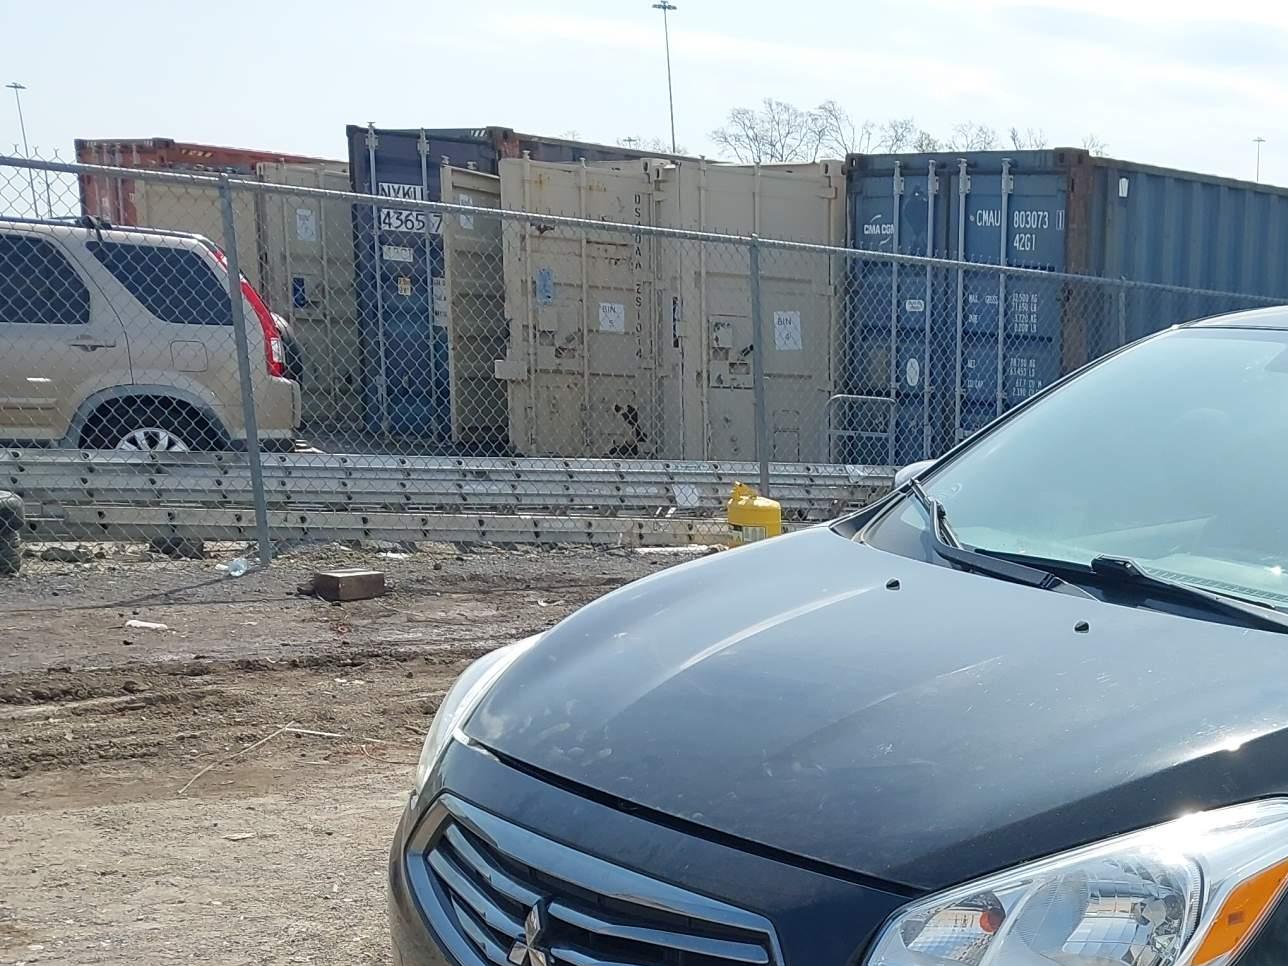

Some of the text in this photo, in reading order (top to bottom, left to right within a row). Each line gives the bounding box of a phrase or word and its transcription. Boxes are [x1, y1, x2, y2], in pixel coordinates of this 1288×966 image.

[976, 209, 1001, 227] CMAU
[1013, 211, 1049, 229] 803073
[864, 224, 880, 235] CMA
[1013, 234, 1036, 251] 42G1
